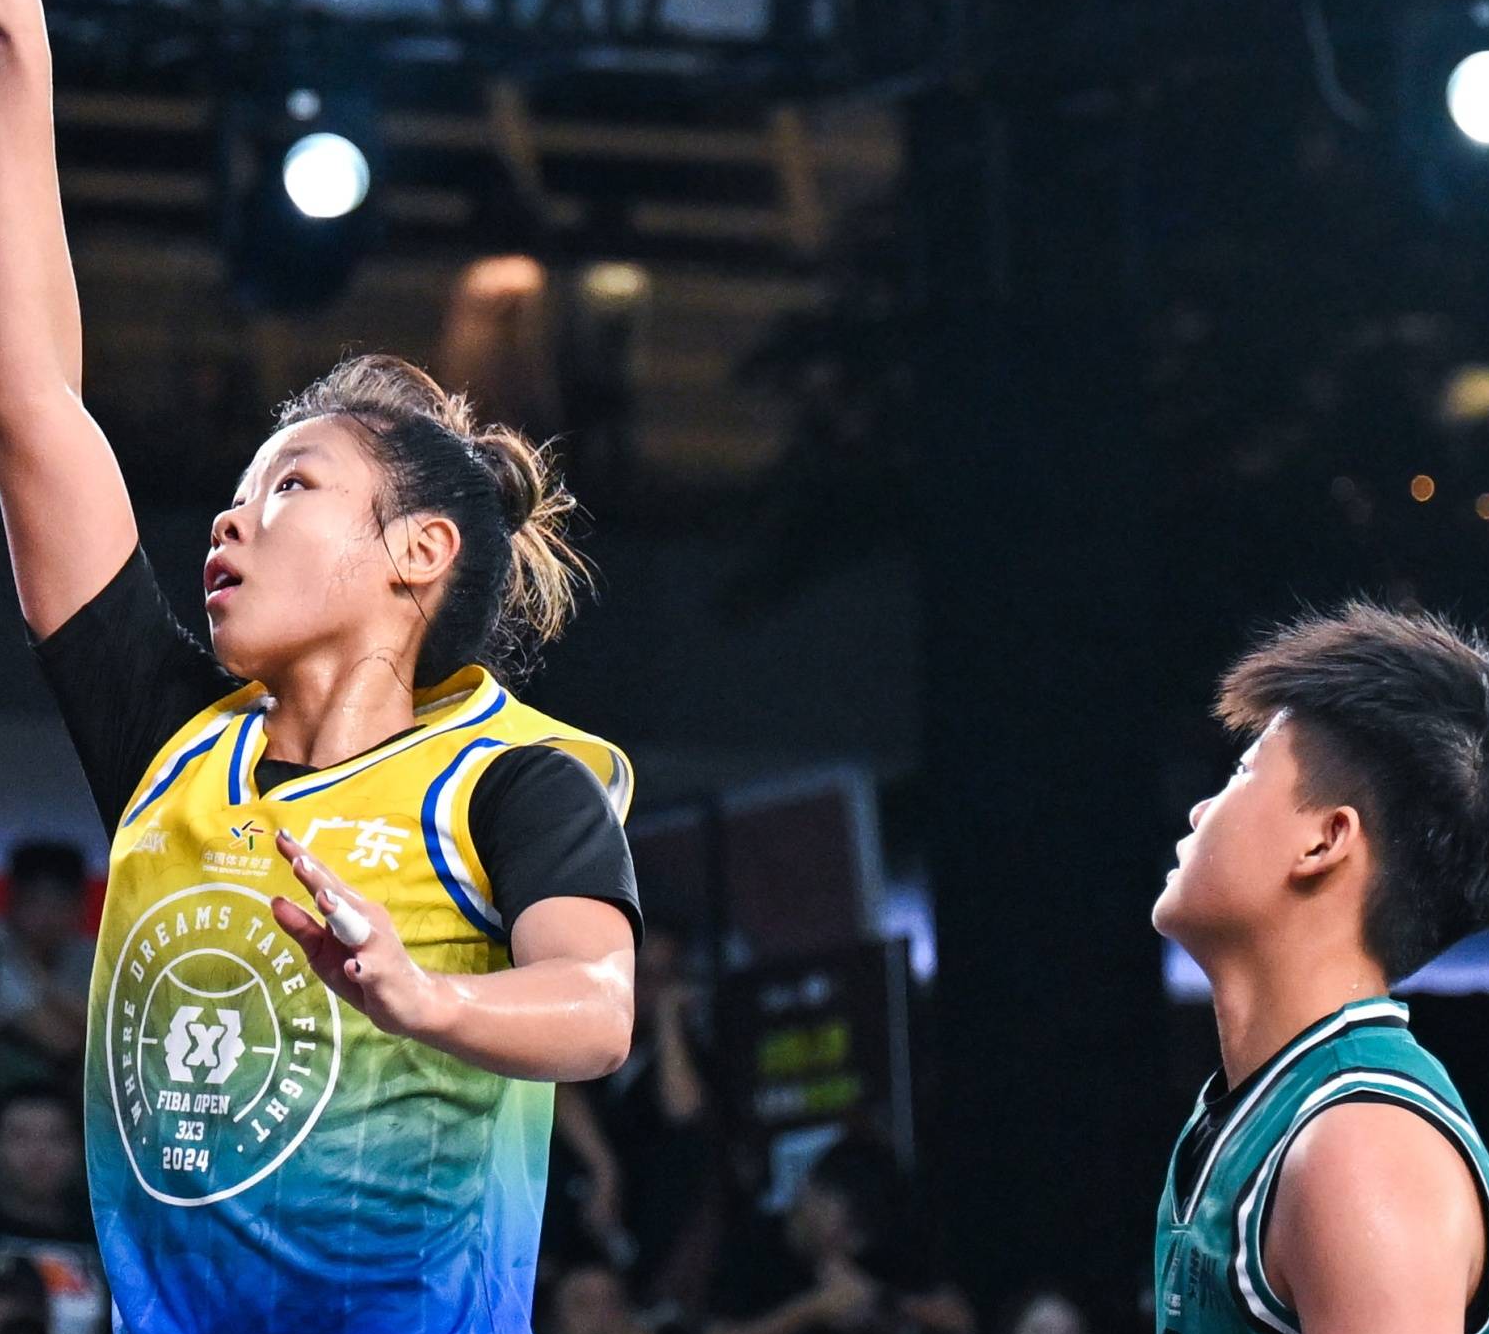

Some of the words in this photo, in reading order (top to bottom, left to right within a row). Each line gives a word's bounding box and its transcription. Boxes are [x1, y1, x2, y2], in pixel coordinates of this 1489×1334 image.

[299, 817, 411, 872] 广东
[130, 905, 232, 983] DREAMS
[245, 917, 307, 995] TAKE
[124, 1000, 142, 1126] WHERE
[250, 1017, 316, 1143] FLIGHT
[157, 1090, 190, 1113] FIBA
[194, 1093, 231, 1115] OPEN
[175, 1121, 203, 1141] 3X3
[162, 1146, 210, 1173] 2024
